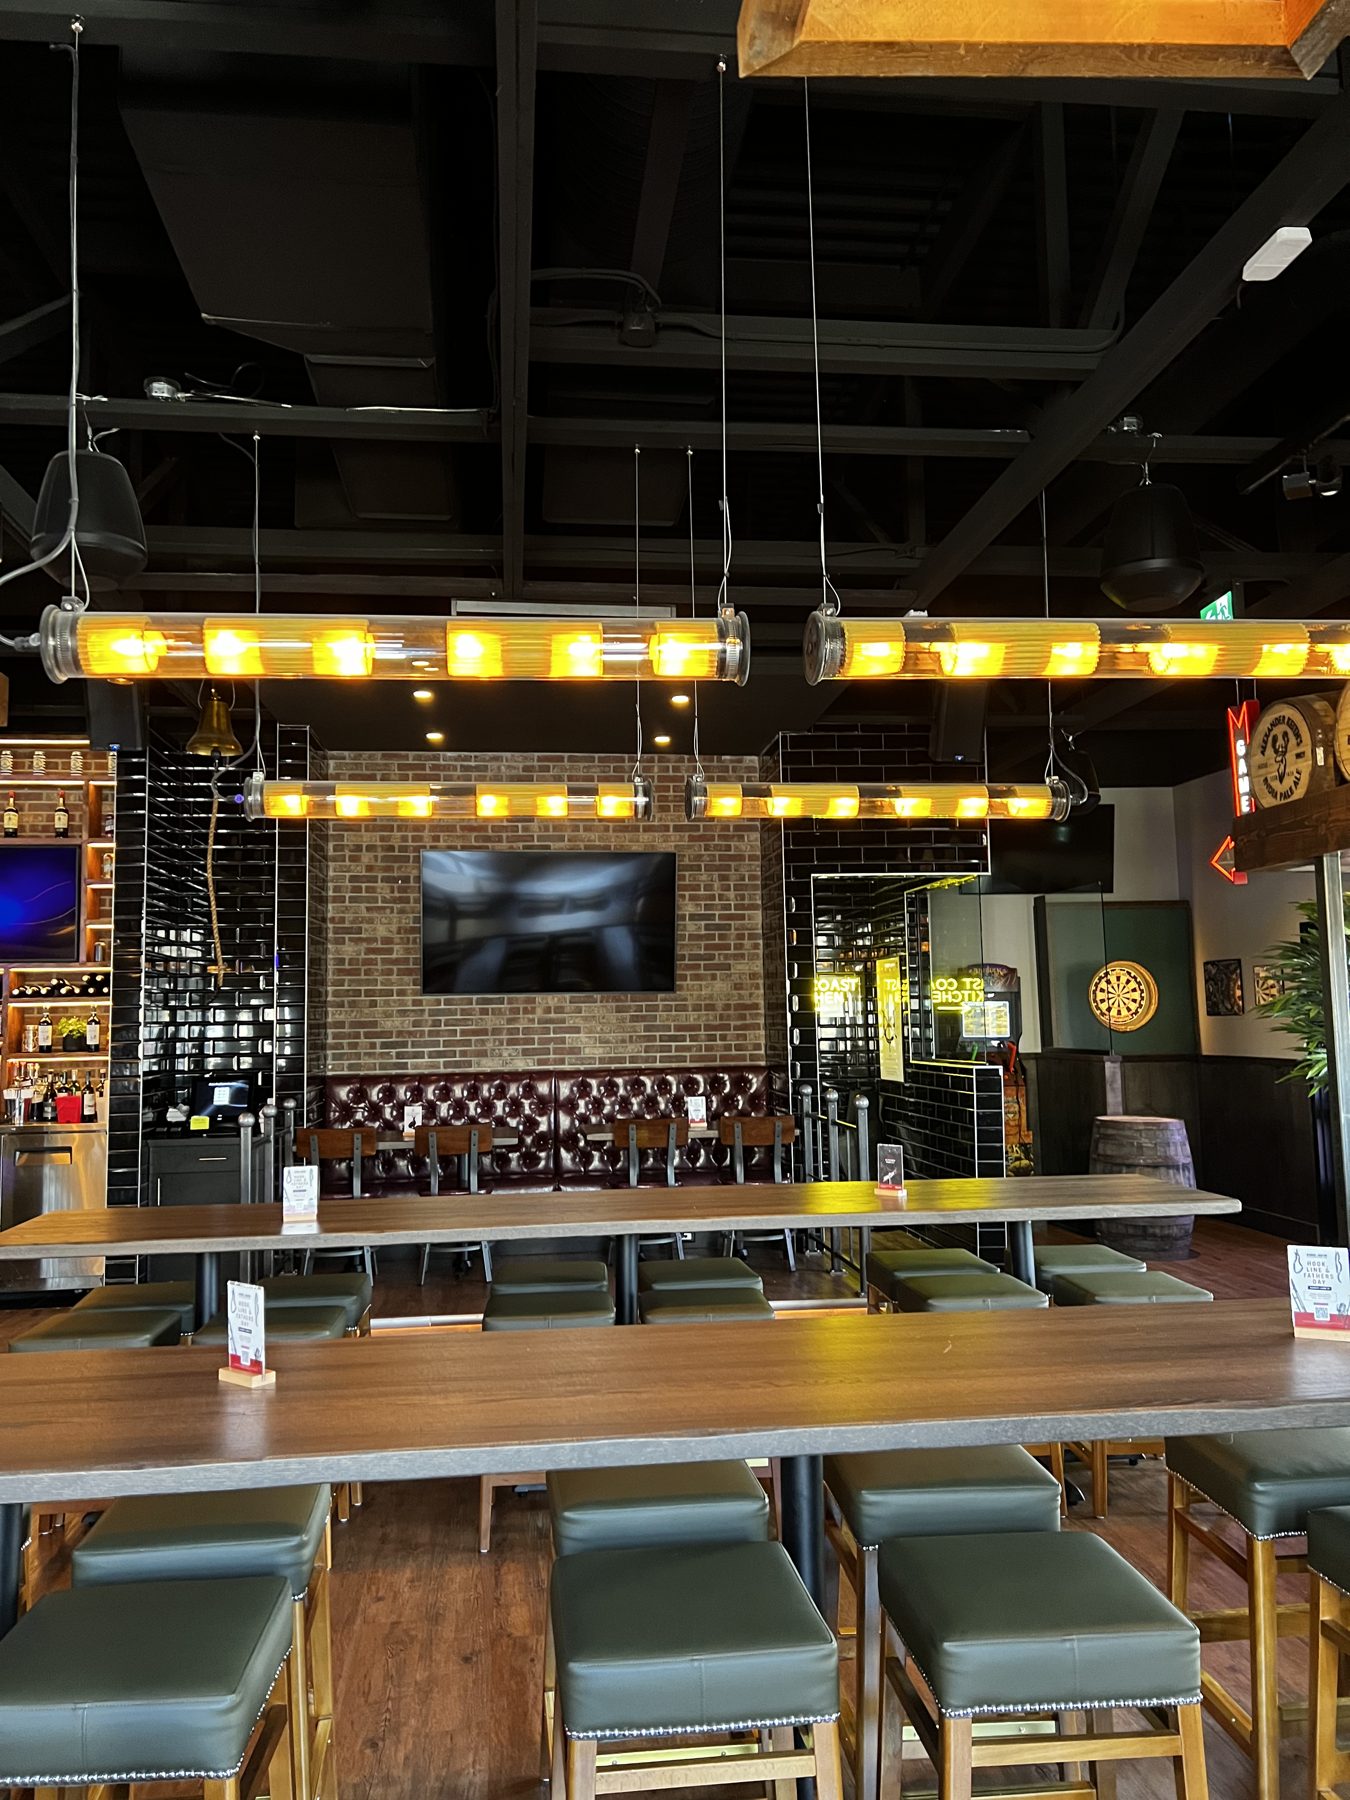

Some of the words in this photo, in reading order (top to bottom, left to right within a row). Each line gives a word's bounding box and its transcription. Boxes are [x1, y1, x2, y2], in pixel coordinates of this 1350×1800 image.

[1260, 714, 1286, 757] ALEXANDER
[1262, 776, 1278, 800] INDIA
[1279, 785, 1295, 801] PALE
[1293, 768, 1303, 790] ALE
